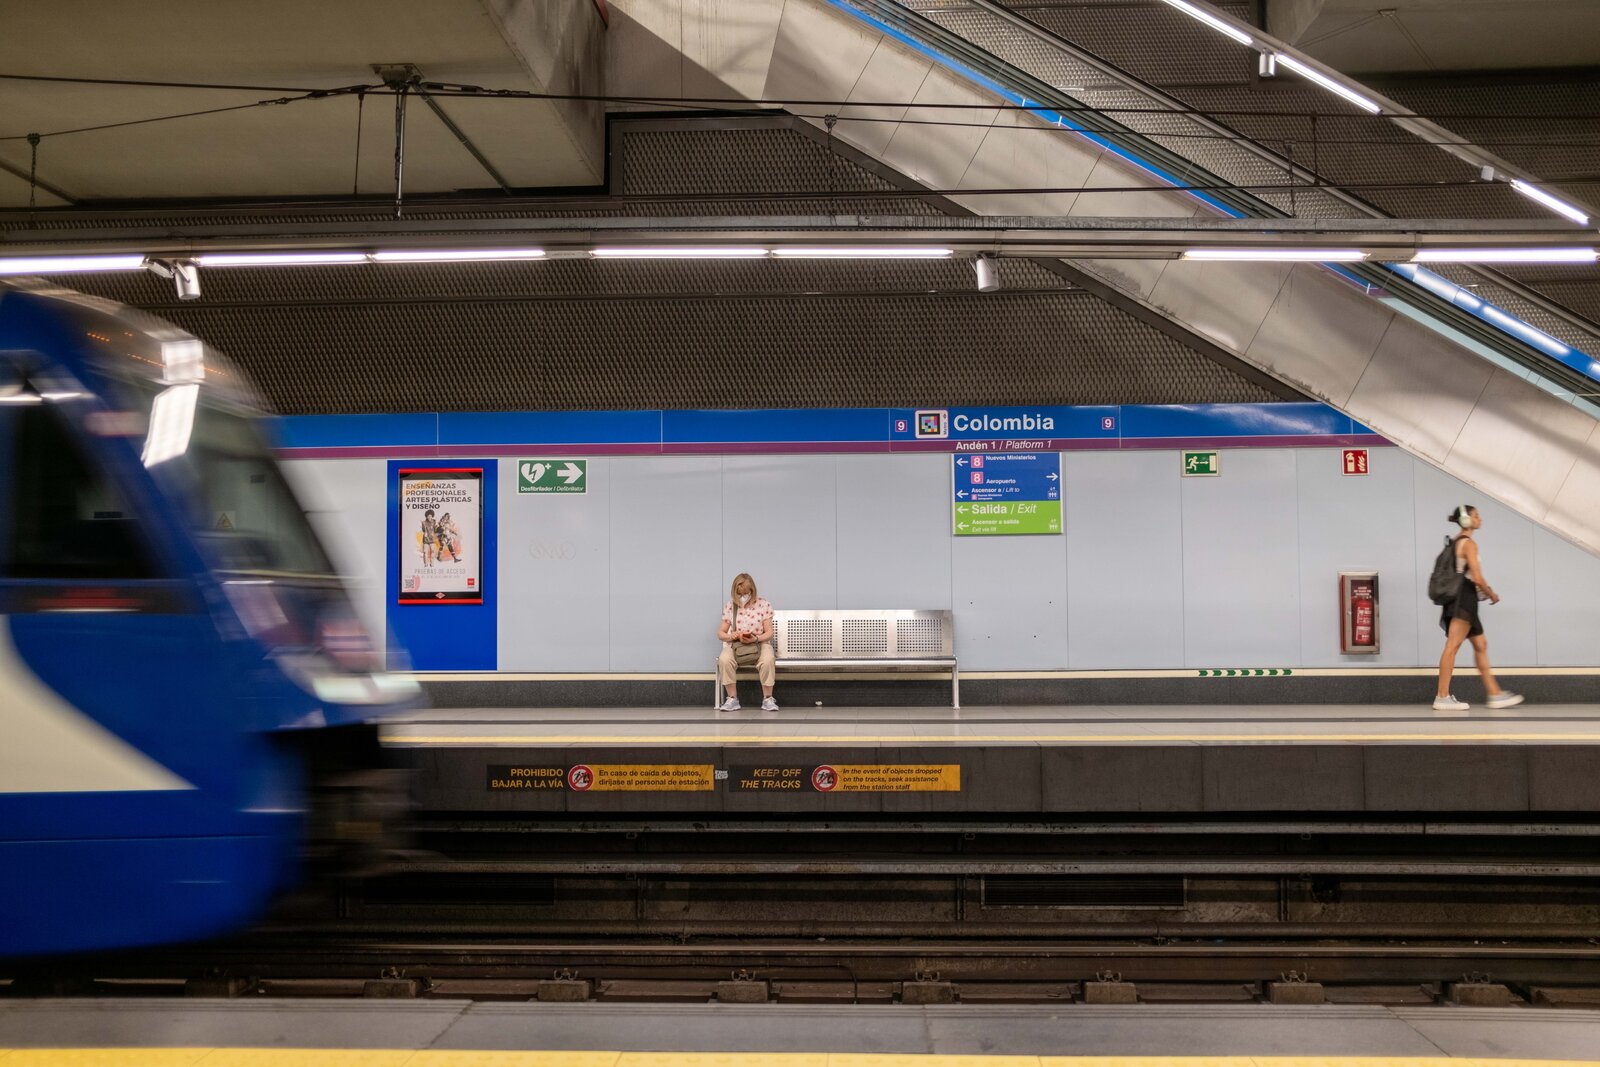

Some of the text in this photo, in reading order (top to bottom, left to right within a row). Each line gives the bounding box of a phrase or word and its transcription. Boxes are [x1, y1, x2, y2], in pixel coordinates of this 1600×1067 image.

[897, 421, 905, 431] 9
[953, 414, 1054, 431] Colombia
[1104, 418, 1112, 428] 9
[956, 441, 988, 450] Andén
[991, 442, 996, 450] 1
[1005, 440, 1044, 449] Platform
[1047, 440, 1052, 448] 1
[973, 457, 981, 466] 8
[973, 473, 981, 482] 8
[971, 504, 1008, 514] Salida
[1017, 504, 1037, 514] Exit
[510, 768, 564, 776] PROHIBIDO
[672, 770, 702, 778] objetos,
[754, 768, 802, 776] KEEP OFF
[492, 780, 523, 788] BAJAR
[548, 778, 564, 788] VÍA
[740, 780, 801, 788] THE TRACKS
